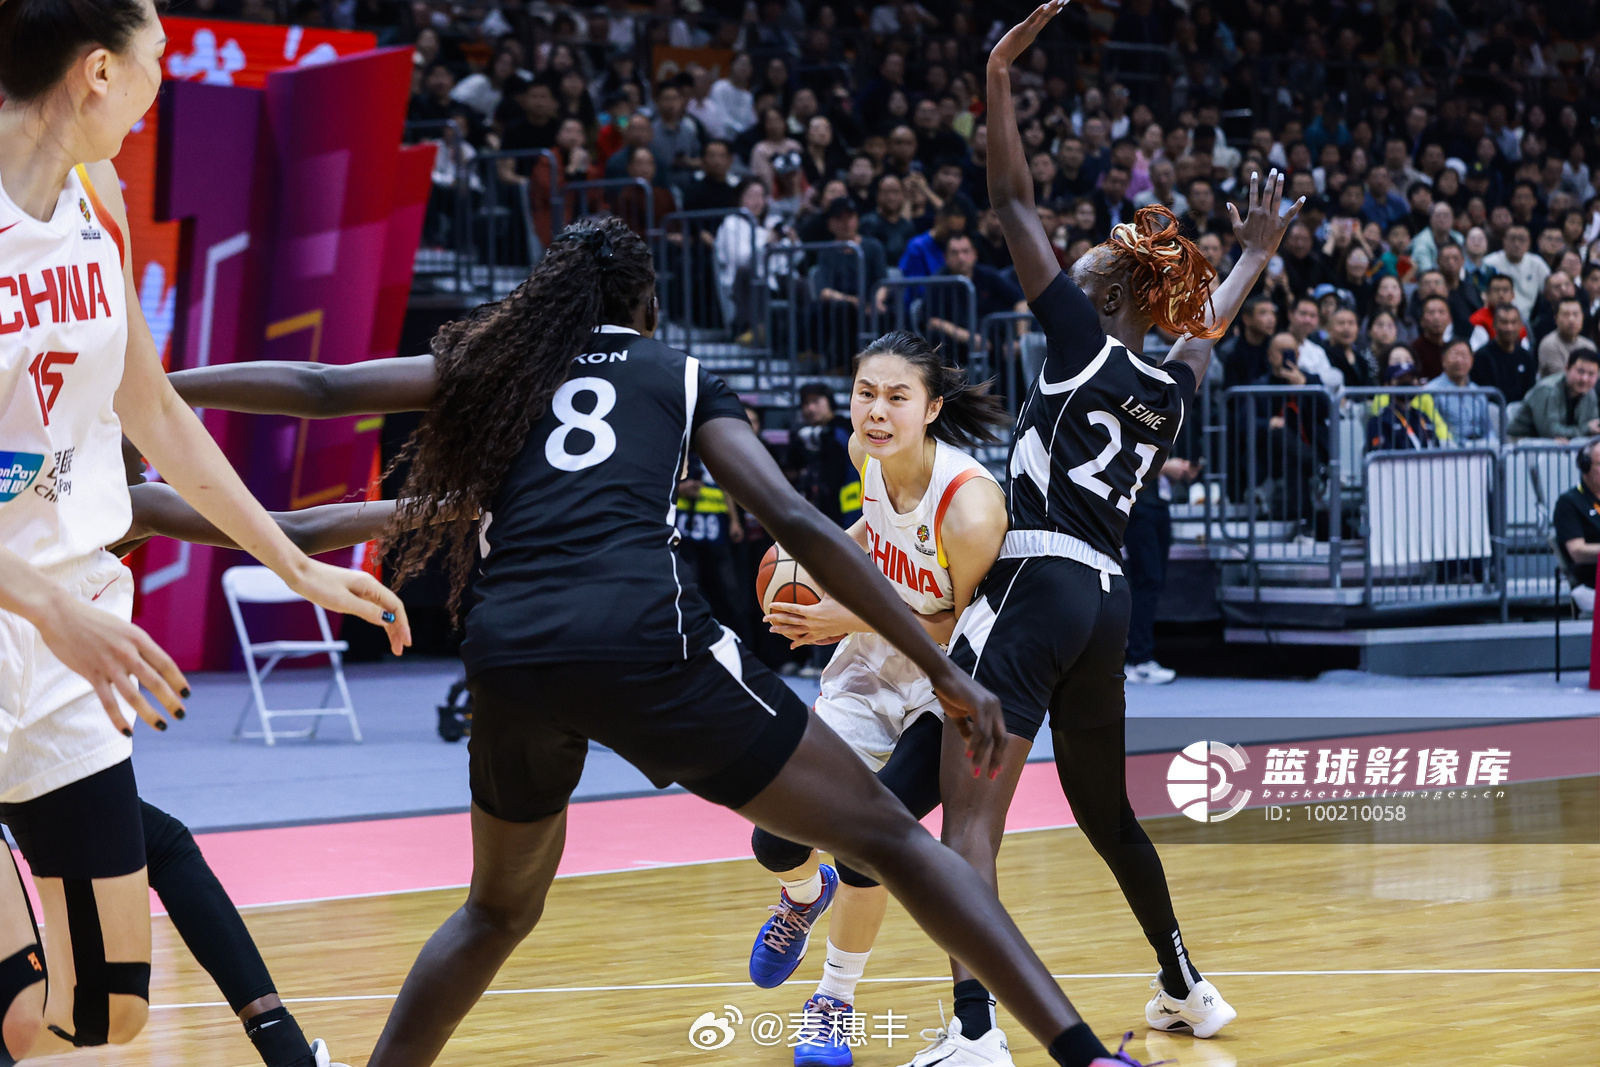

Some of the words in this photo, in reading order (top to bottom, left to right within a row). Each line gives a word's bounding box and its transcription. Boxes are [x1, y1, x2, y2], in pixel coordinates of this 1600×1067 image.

[0, 262, 112, 335] CHINA
[28, 350, 79, 427] 15
[544, 376, 617, 473] 8
[1120, 395, 1167, 431] LEIME
[1067, 410, 1160, 518] 21
